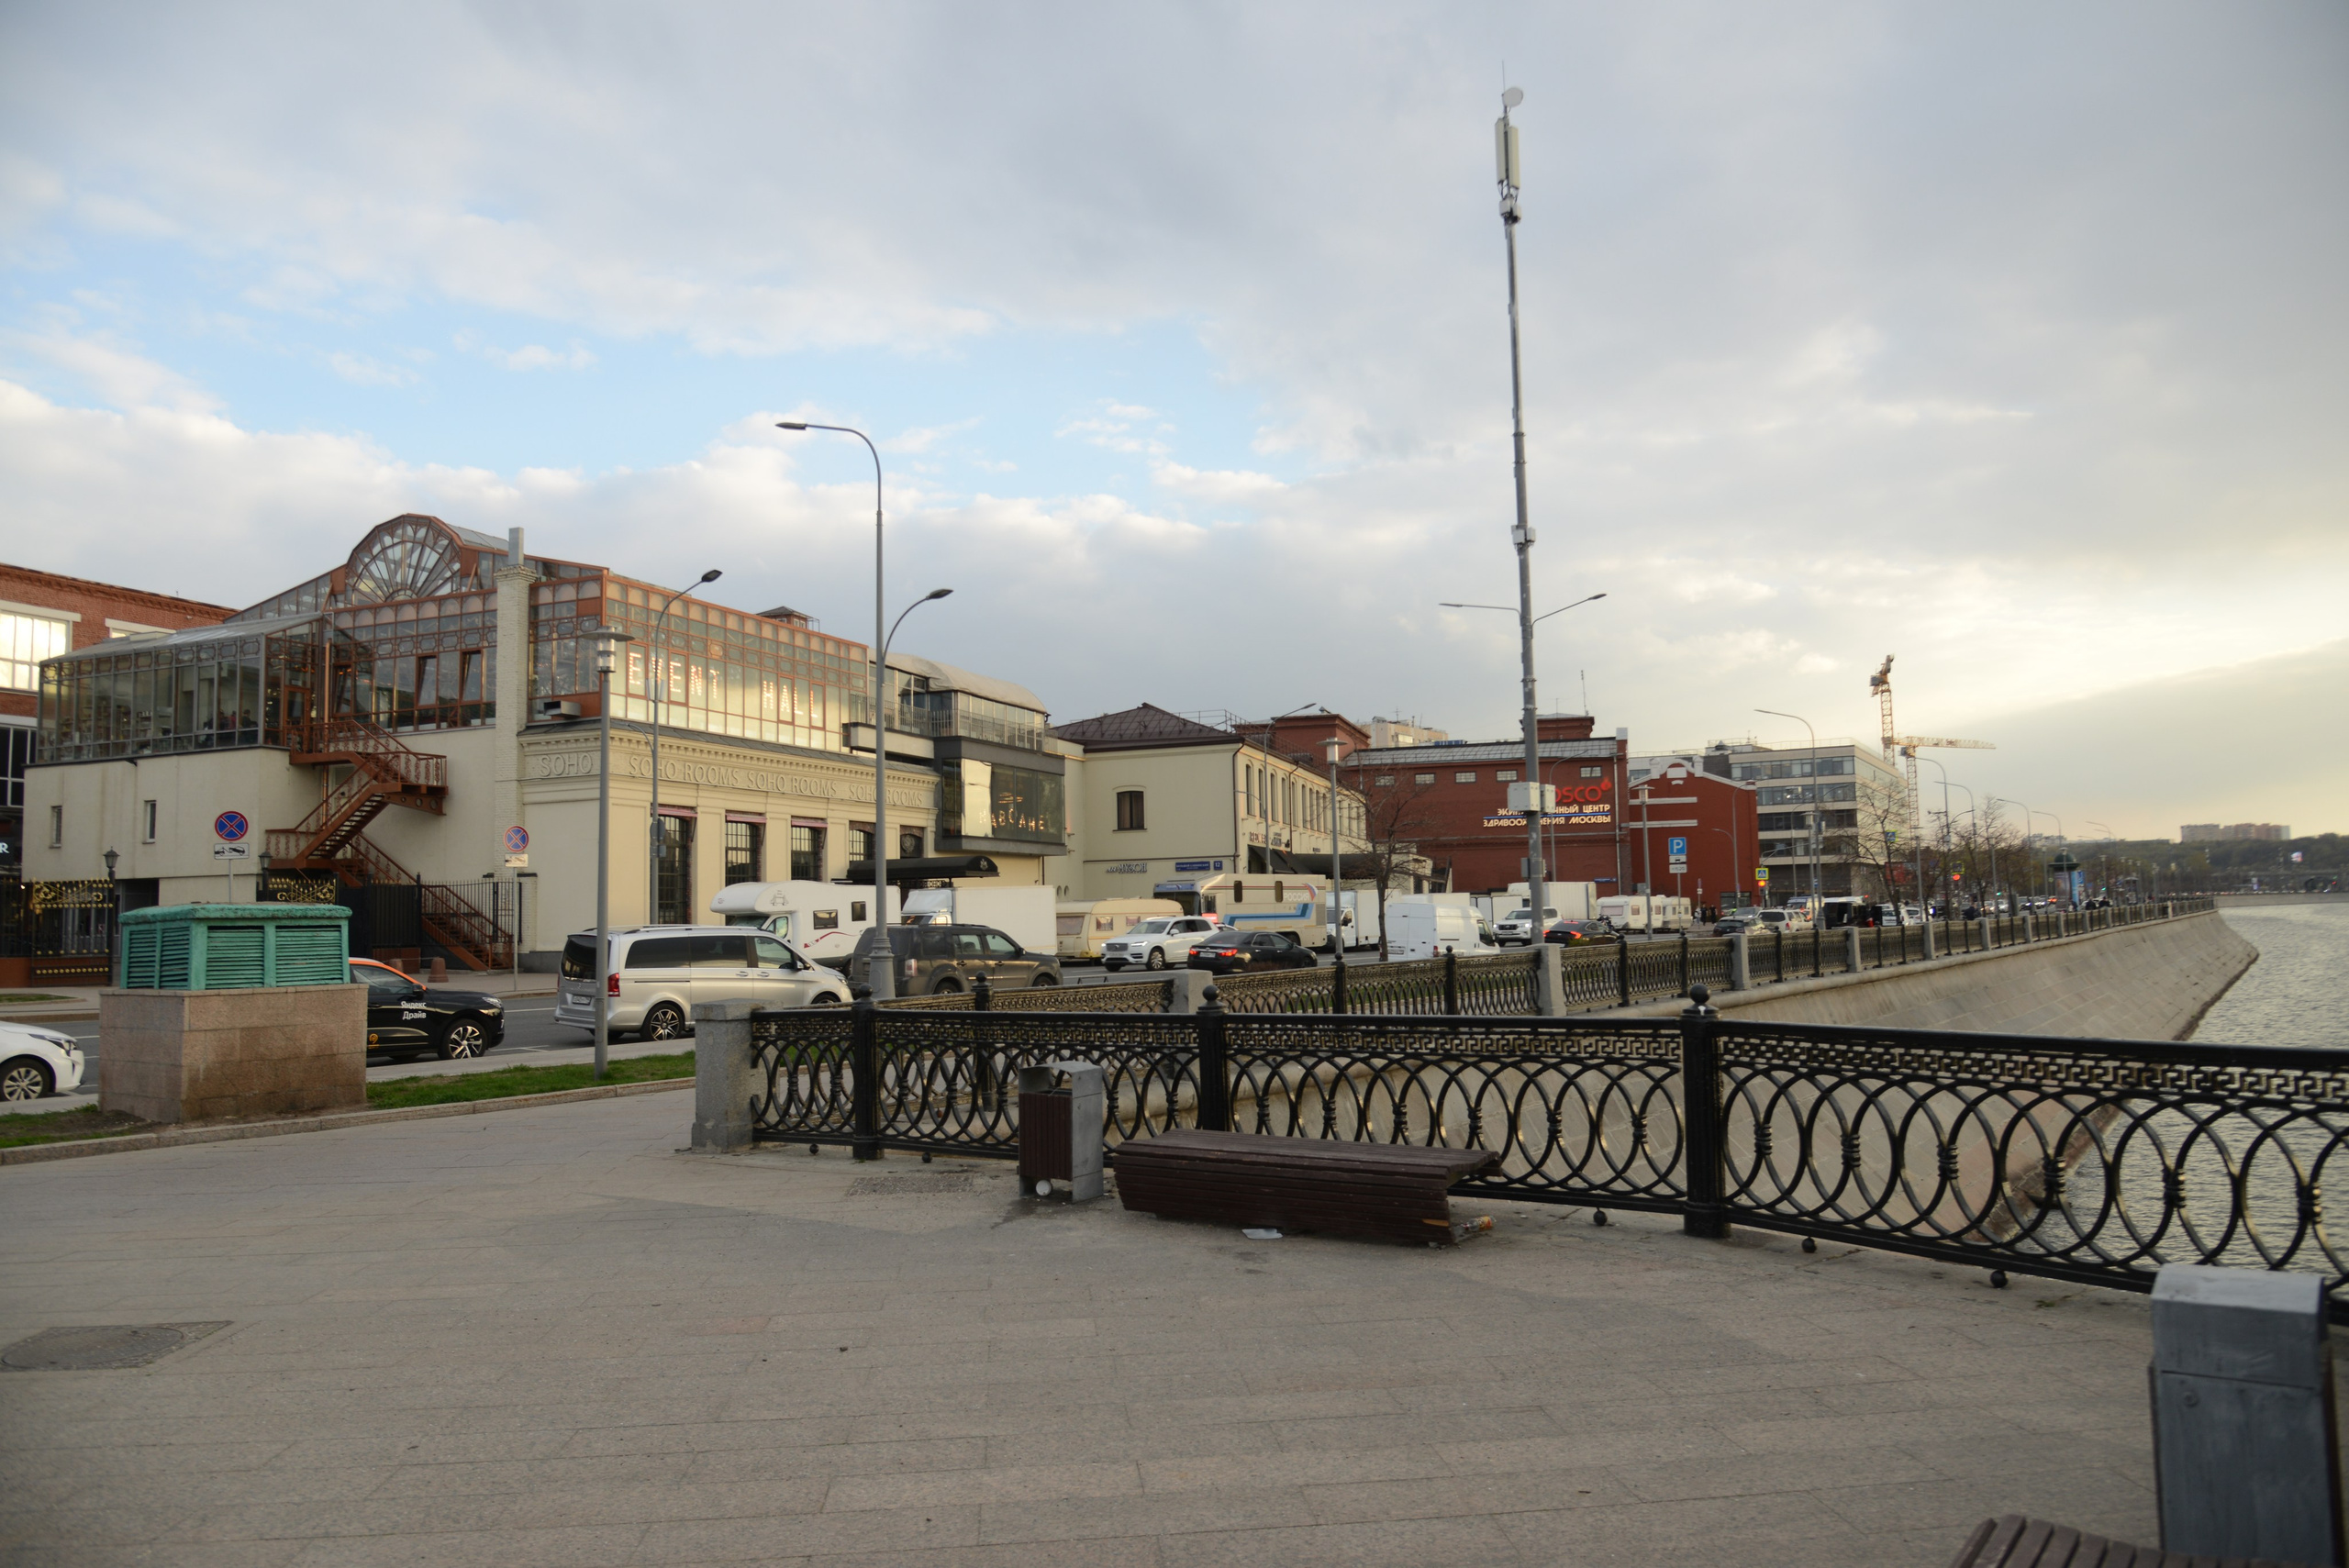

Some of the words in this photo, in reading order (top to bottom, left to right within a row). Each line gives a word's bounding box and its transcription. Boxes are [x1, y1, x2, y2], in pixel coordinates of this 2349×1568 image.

[629, 651, 719, 699] EVENT
[763, 680, 818, 718] HALL
[540, 751, 594, 778] SOHO
[684, 762, 740, 787] ROOMS
[747, 770, 786, 792] SOHO
[791, 776, 837, 798] ROOMS
[1555, 785, 1602, 803] SCO
[1583, 804, 1611, 814] ЦЕНТР
[1569, 815, 1611, 825] МОСКВЫ
[1673, 839, 1684, 853] P
[1283, 892, 1310, 902] РОССИЯ
[400, 1000, 428, 1010] Яндекс
[402, 1010, 427, 1020] Драйв
